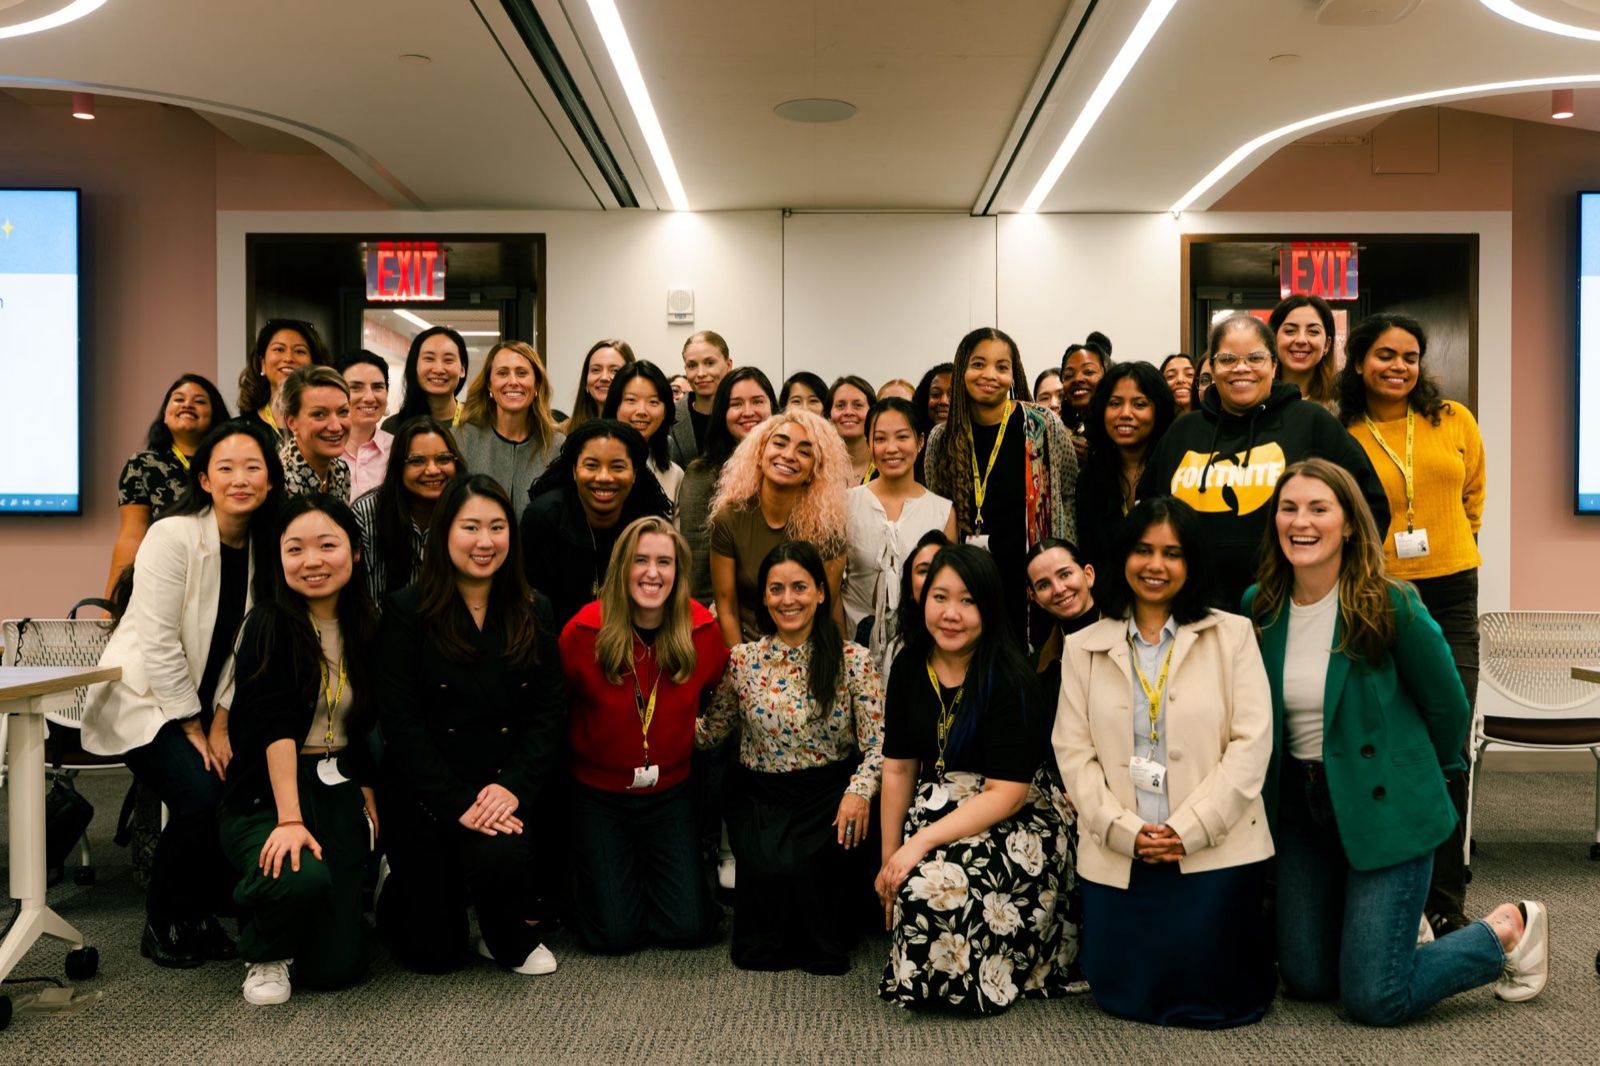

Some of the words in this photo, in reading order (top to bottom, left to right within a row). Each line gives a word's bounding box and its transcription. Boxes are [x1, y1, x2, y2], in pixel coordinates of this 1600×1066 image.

[377, 249, 438, 297] EXIT
[1291, 249, 1351, 297] EXIT
[1171, 461, 1284, 495] FORTNITE
